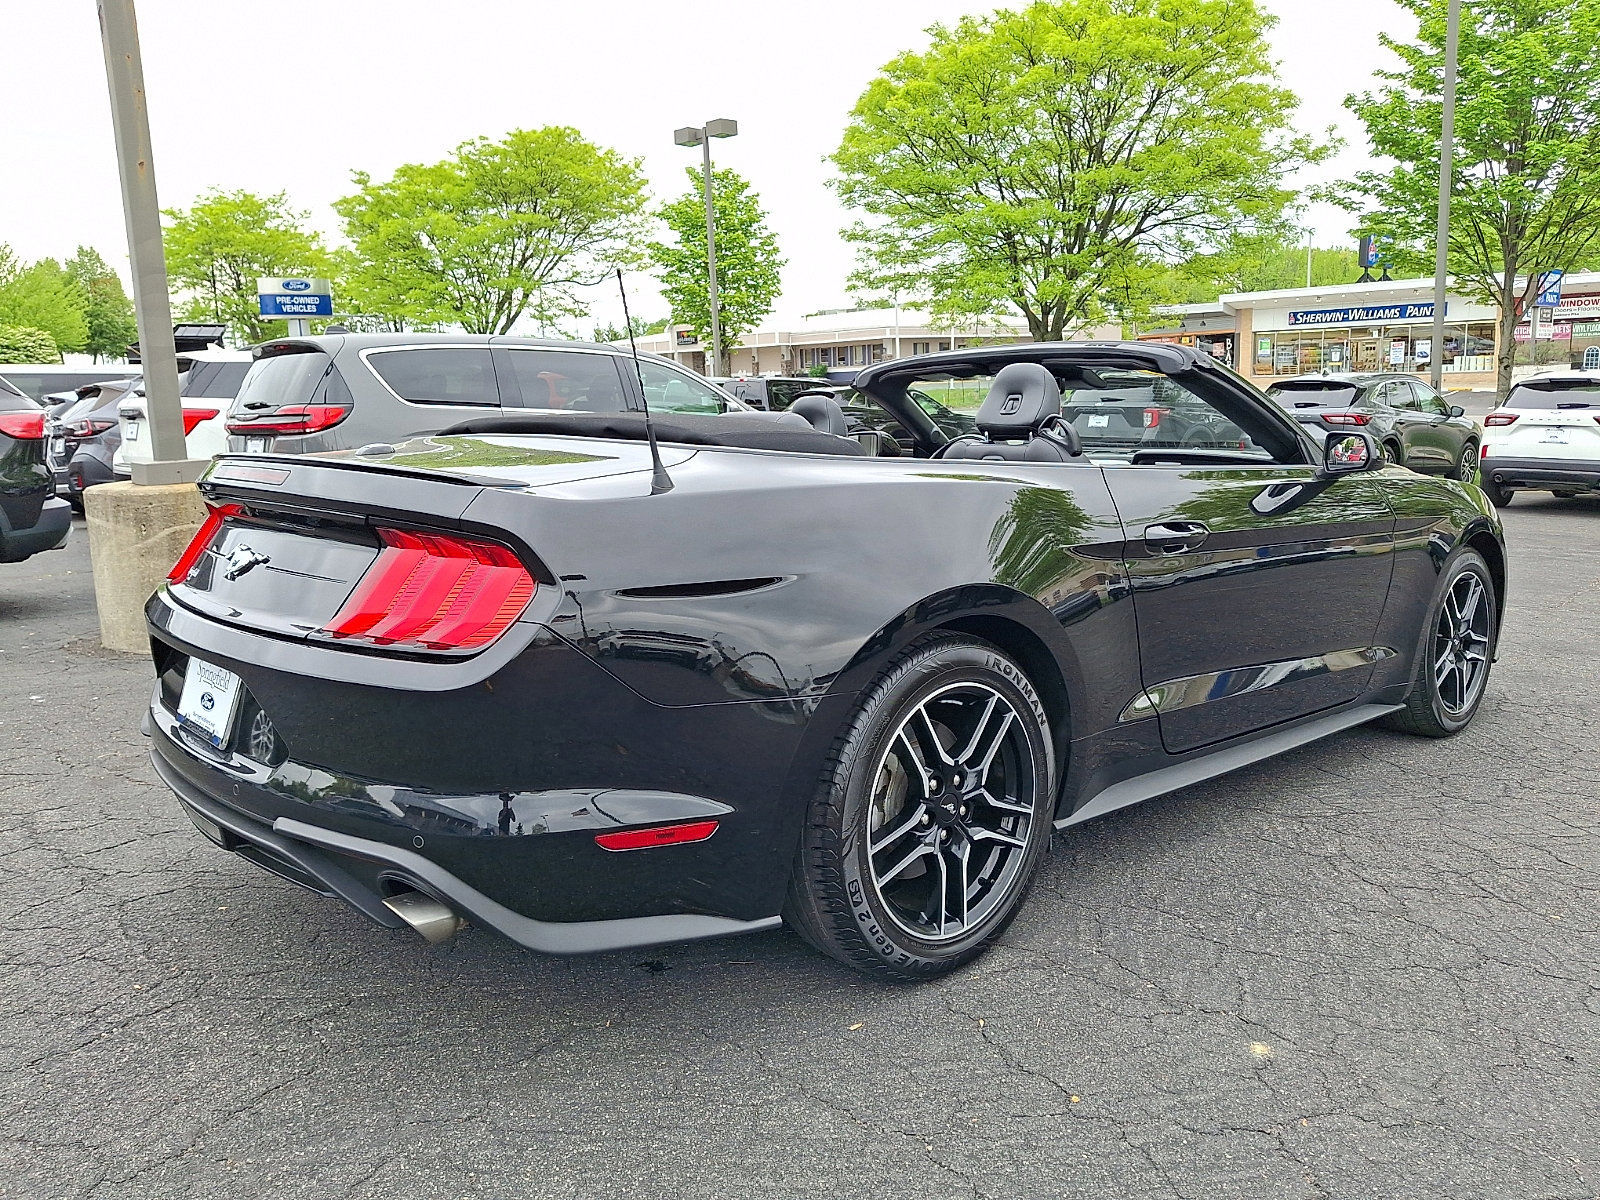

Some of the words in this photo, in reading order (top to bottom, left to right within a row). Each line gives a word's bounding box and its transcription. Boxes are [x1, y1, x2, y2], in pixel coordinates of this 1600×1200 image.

[275, 296, 320, 304] PRE-OWNED
[282, 305, 317, 313] VEHICLES
[1295, 308, 1400, 324] SHERWIN-WILLIAMS
[1405, 305, 1435, 318] PAINT
[985, 655, 1046, 727] IRONMAN
[848, 879, 863, 908] AS
[858, 910, 872, 922] 2
